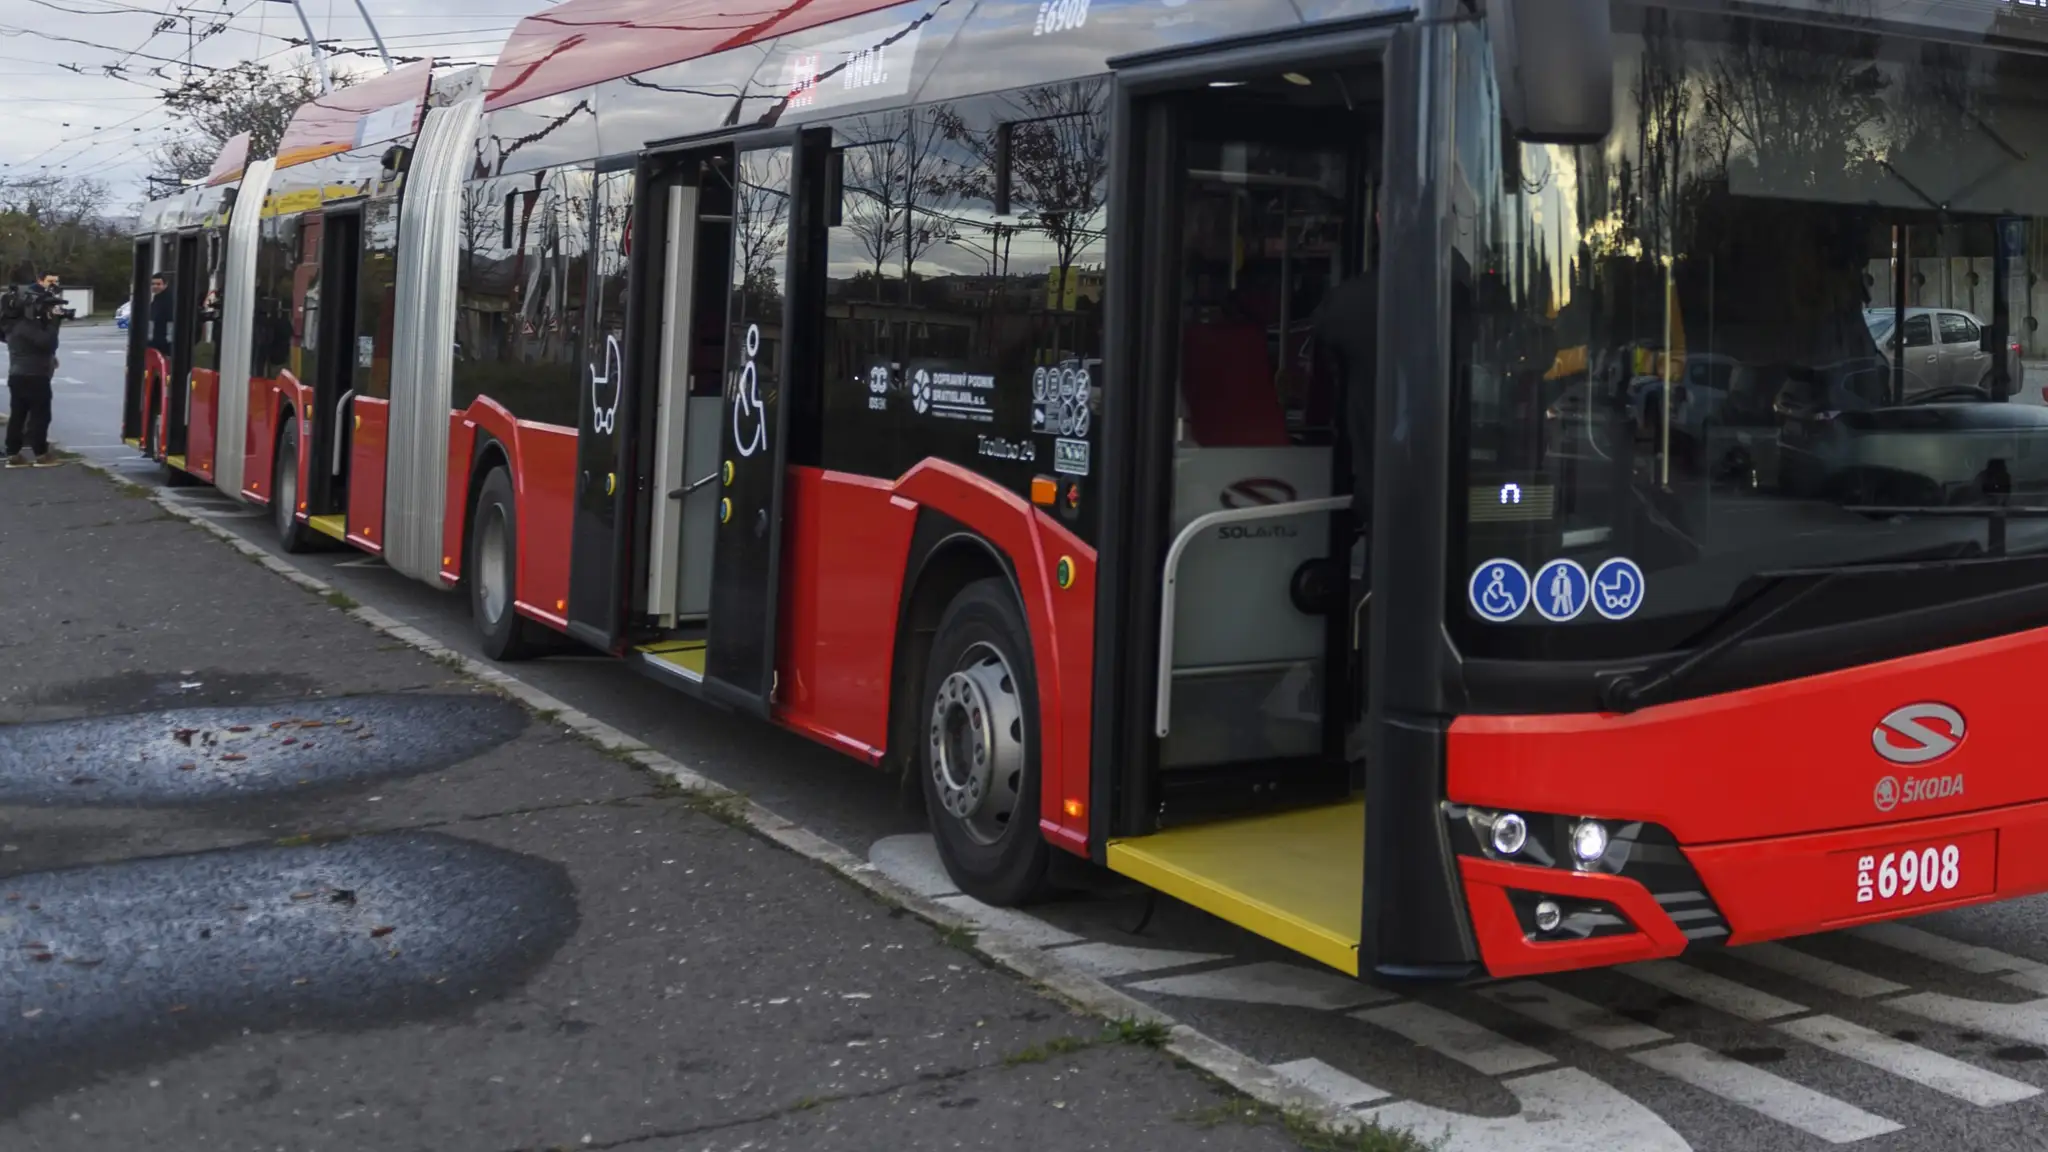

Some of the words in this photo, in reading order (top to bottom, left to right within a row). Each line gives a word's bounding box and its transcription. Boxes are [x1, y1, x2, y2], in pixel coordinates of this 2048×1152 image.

[1044, 0, 1091, 33] 6908
[1901, 773, 1964, 803] ŠKODA
[1857, 855, 1875, 902] DPB
[1878, 844, 1960, 898] 6908
